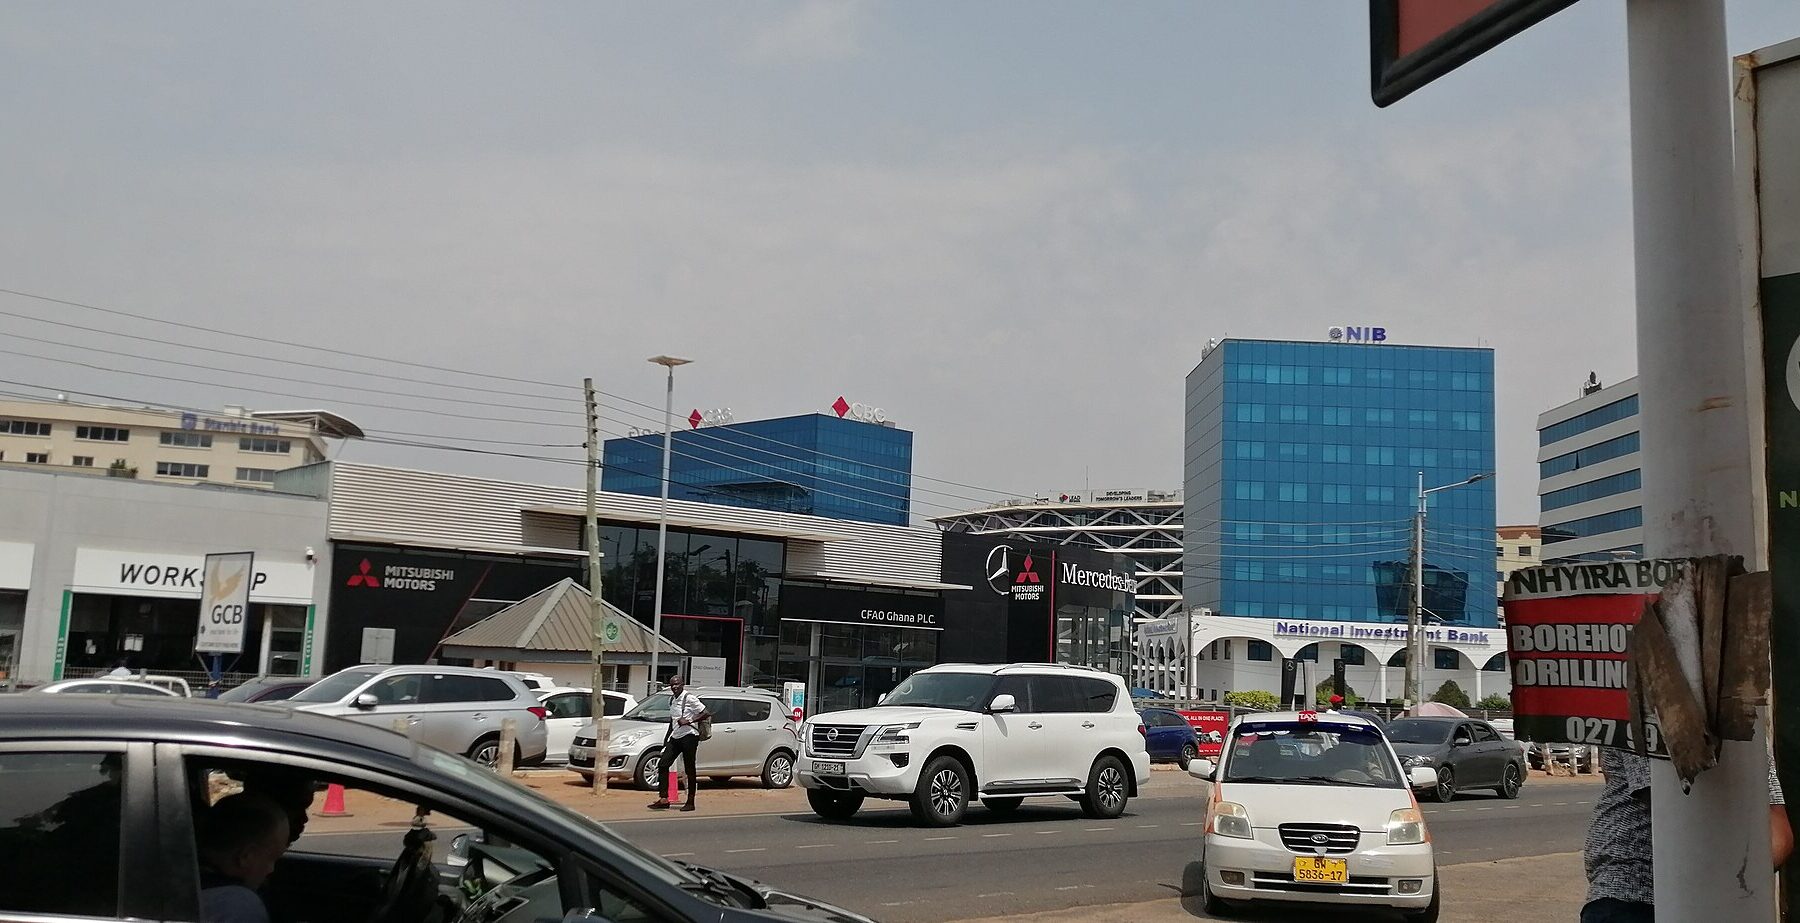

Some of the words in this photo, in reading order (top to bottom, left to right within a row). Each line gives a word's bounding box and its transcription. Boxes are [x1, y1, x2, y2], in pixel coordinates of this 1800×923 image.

[1347, 326, 1386, 341] NIB
[1779, 490, 1800, 508] N
[119, 563, 267, 592] WORKP
[384, 565, 454, 580] MITSUBISHI
[1513, 561, 1632, 595] NHYIRA
[383, 578, 436, 591] MOTORS
[1011, 585, 1044, 593] MITSUBISHI
[211, 604, 243, 625] GCB
[861, 609, 885, 621] CFAO
[886, 611, 915, 623] Ghana
[917, 613, 936, 624] PLC.
[1277, 622, 1344, 636] National
[1350, 625, 1442, 640] Investmnt
[1448, 629, 1489, 643] Bank
[1512, 623, 1634, 653] BOREHO
[1516, 659, 1628, 688] DRILLIN
[1566, 716, 1616, 746] 027
[1299, 869, 1343, 881] 5836-17
